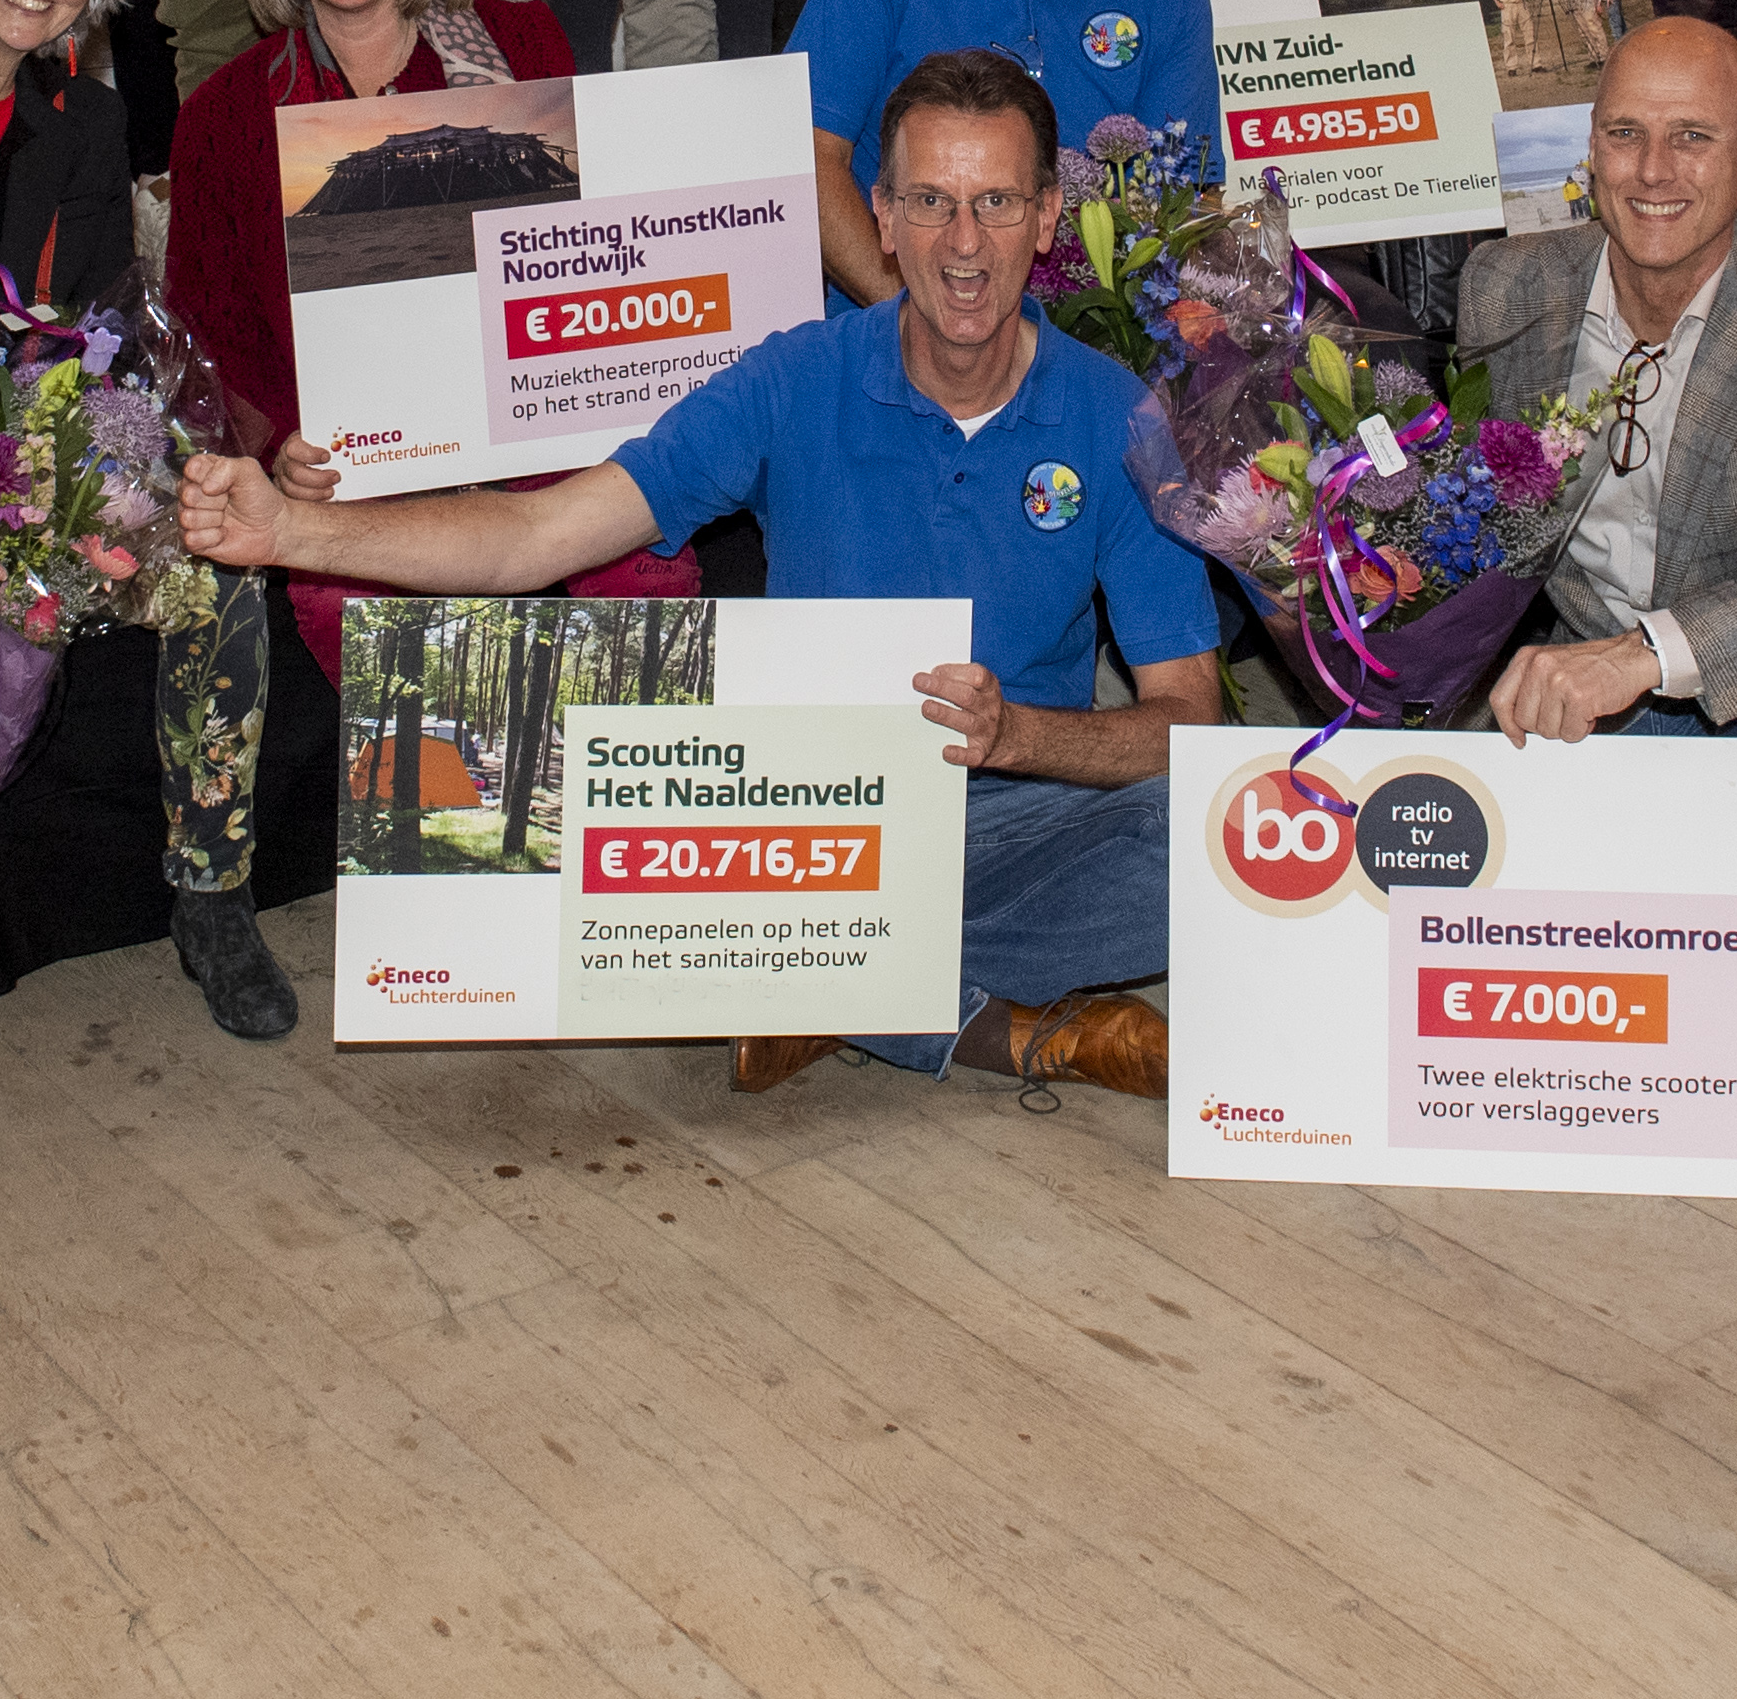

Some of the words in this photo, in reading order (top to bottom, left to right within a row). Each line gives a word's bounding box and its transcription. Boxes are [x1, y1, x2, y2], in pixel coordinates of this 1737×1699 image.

[1215, 40, 1267, 66] IVN
[1274, 33, 1344, 60] Zuid-
[1221, 54, 1416, 95] Kennemerland
[1240, 118, 1265, 148] €
[1271, 102, 1420, 143] 4.985,50
[1343, 163, 1384, 181] voor
[1316, 186, 1390, 209] podcast
[1394, 180, 1420, 197] De
[1423, 173, 1497, 195] Tierelier
[500, 221, 622, 256] Stichting
[632, 199, 785, 240] KunstKlank
[503, 248, 646, 285] Noordwijk
[526, 308, 551, 342] €
[560, 289, 717, 338] 20.000,-
[513, 400, 538, 421] op
[544, 393, 579, 414] het
[585, 385, 651, 409] strand
[658, 380, 681, 398] en
[344, 428, 402, 447] Eneco
[351, 439, 461, 467] Luchterduinen
[587, 736, 745, 773] Scouting
[587, 778, 655, 808] Het
[665, 776, 884, 807] Naaldenveld
[1243, 788, 1341, 864] bo
[1391, 801, 1452, 823] radio
[1410, 827, 1434, 846] tv
[600, 840, 629, 878] €
[639, 838, 867, 884] 20.716,57
[1374, 847, 1470, 871] internet
[582, 917, 754, 945] Zonnepanelen
[762, 922, 793, 944] op
[801, 917, 841, 939] het
[849, 917, 891, 938] dak
[581, 949, 624, 969] van
[632, 947, 672, 969] het
[680, 946, 868, 973] sanitairgebouw
[384, 967, 450, 985] Eneco
[389, 989, 516, 1005] Luchterduinen
[1442, 981, 1473, 1022] €
[1486, 982, 1646, 1034] 7.000,-
[1418, 1065, 1485, 1088] Twee
[1494, 1067, 1632, 1093] elektrische
[1217, 1102, 1285, 1124] Eneco
[1418, 1099, 1475, 1120] voor
[1483, 1098, 1660, 1129] verslaggevers
[1223, 1125, 1352, 1147] Luchterduinen
